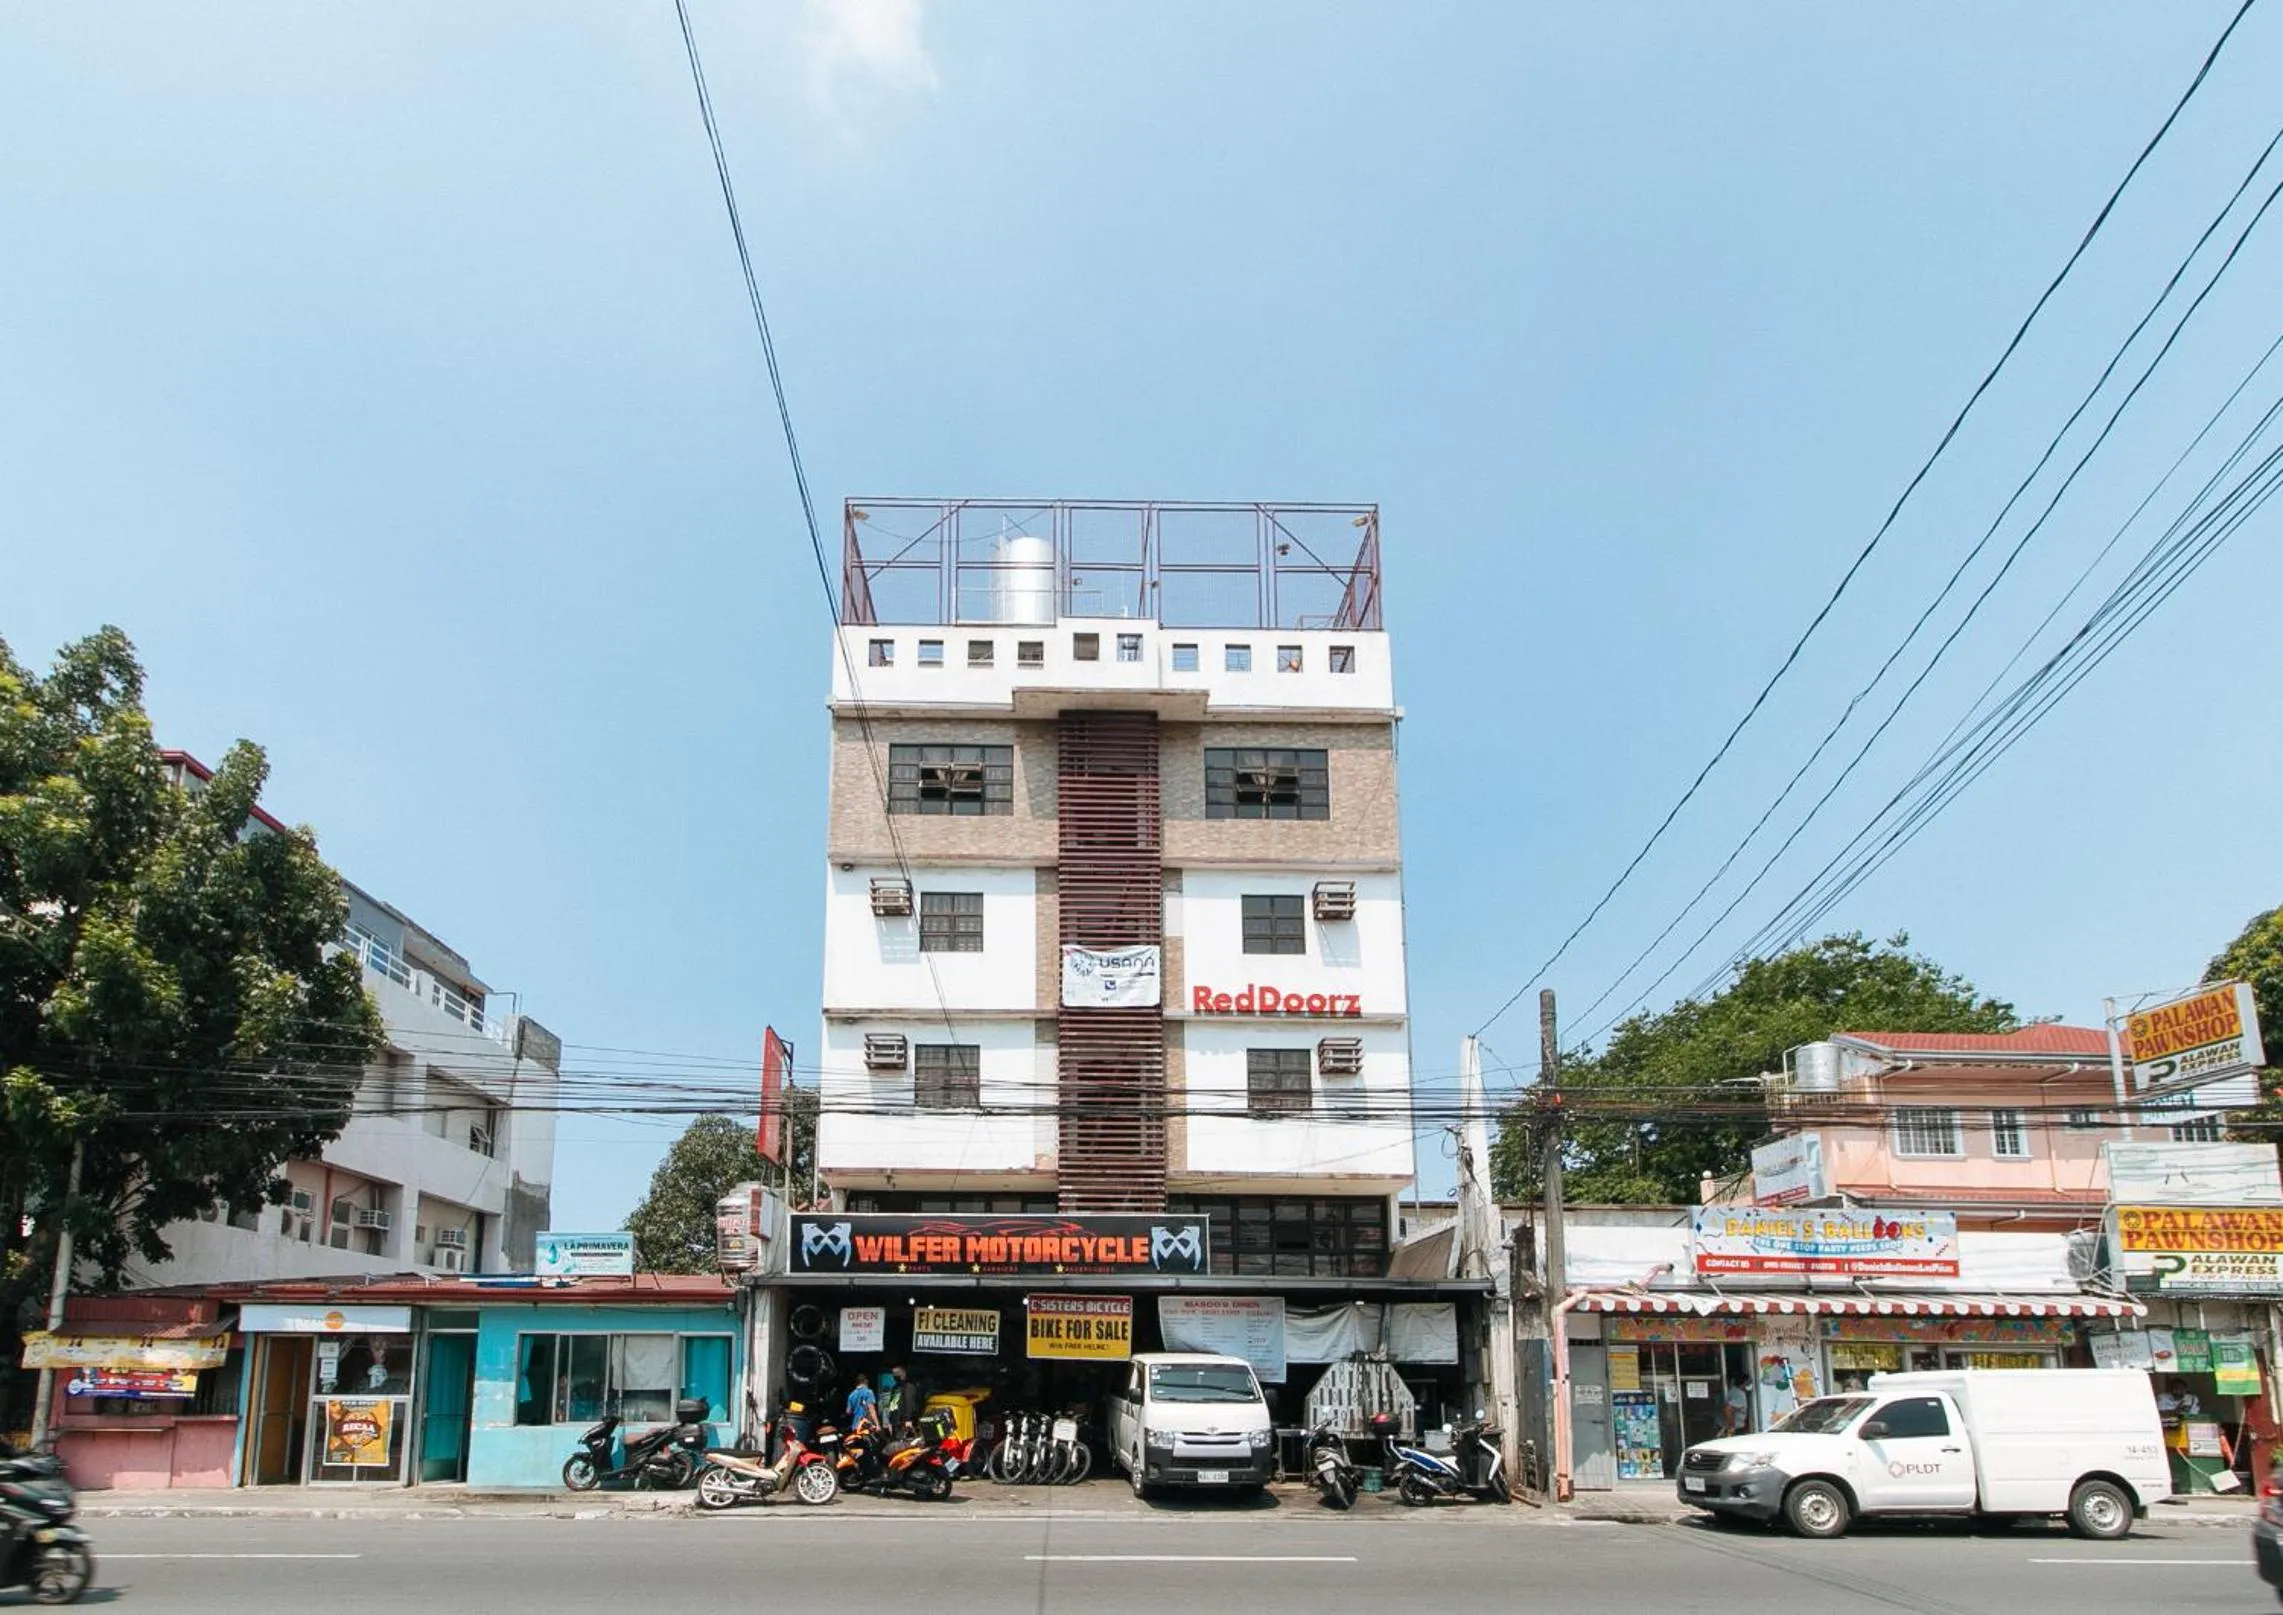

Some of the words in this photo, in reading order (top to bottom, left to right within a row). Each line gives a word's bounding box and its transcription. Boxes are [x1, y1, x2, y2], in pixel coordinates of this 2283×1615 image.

[1193, 984, 1361, 1012] RedDoorz
[2152, 988, 2235, 1031] PALAWAN
[2133, 1013, 2238, 1060] PAWNSHOP
[2143, 1212, 2283, 1230] PALAWAN
[855, 1236, 960, 1263] WILFER
[966, 1236, 1149, 1263] MOTORCYCLE
[2126, 1231, 2283, 1250] PAWNSHOP
[2192, 1266, 2278, 1274] EXPRESS
[848, 1311, 878, 1320] OPEN
[1086, 1301, 1130, 1313] BICYCLE
[933, 1311, 996, 1332] CLEANING
[1031, 1319, 1062, 1338] BIKE
[1066, 1320, 1091, 1339] FOR
[1096, 1320, 1128, 1340] SALE
[917, 1334, 967, 1348] AVAILABLE
[969, 1336, 994, 1349] HERE
[1907, 1463, 1942, 1474] PLDT
